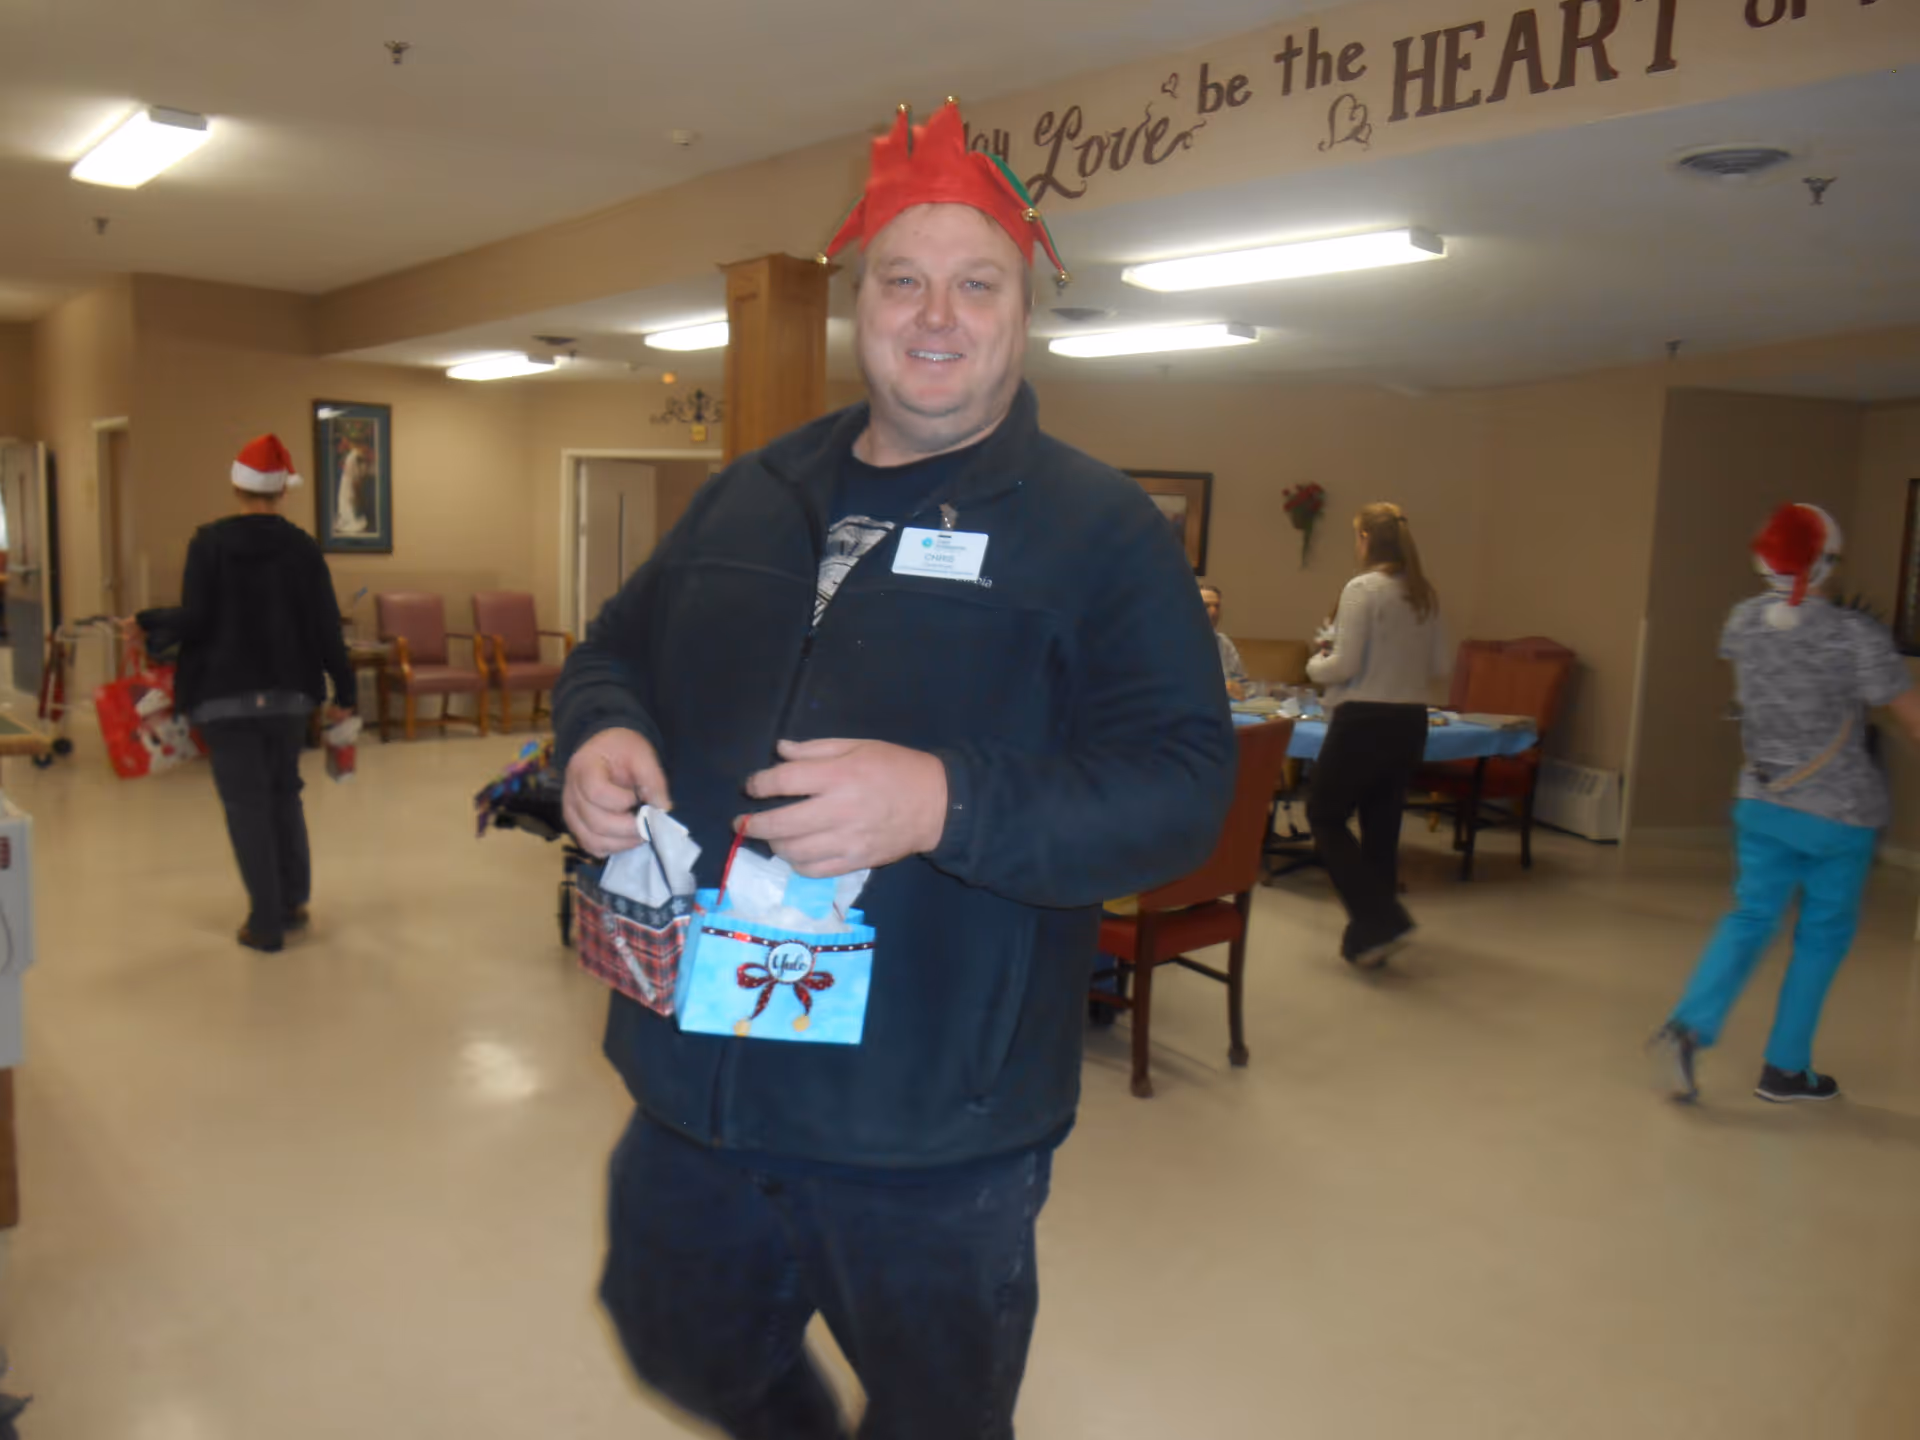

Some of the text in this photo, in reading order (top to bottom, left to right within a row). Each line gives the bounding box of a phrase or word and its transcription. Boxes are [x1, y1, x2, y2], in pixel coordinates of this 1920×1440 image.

[963, 121, 1009, 165] ay
[1027, 102, 1206, 204] Love
[1198, 63, 1252, 115] be
[1274, 27, 1367, 96] the
[1387, 0, 1677, 122] HEART
